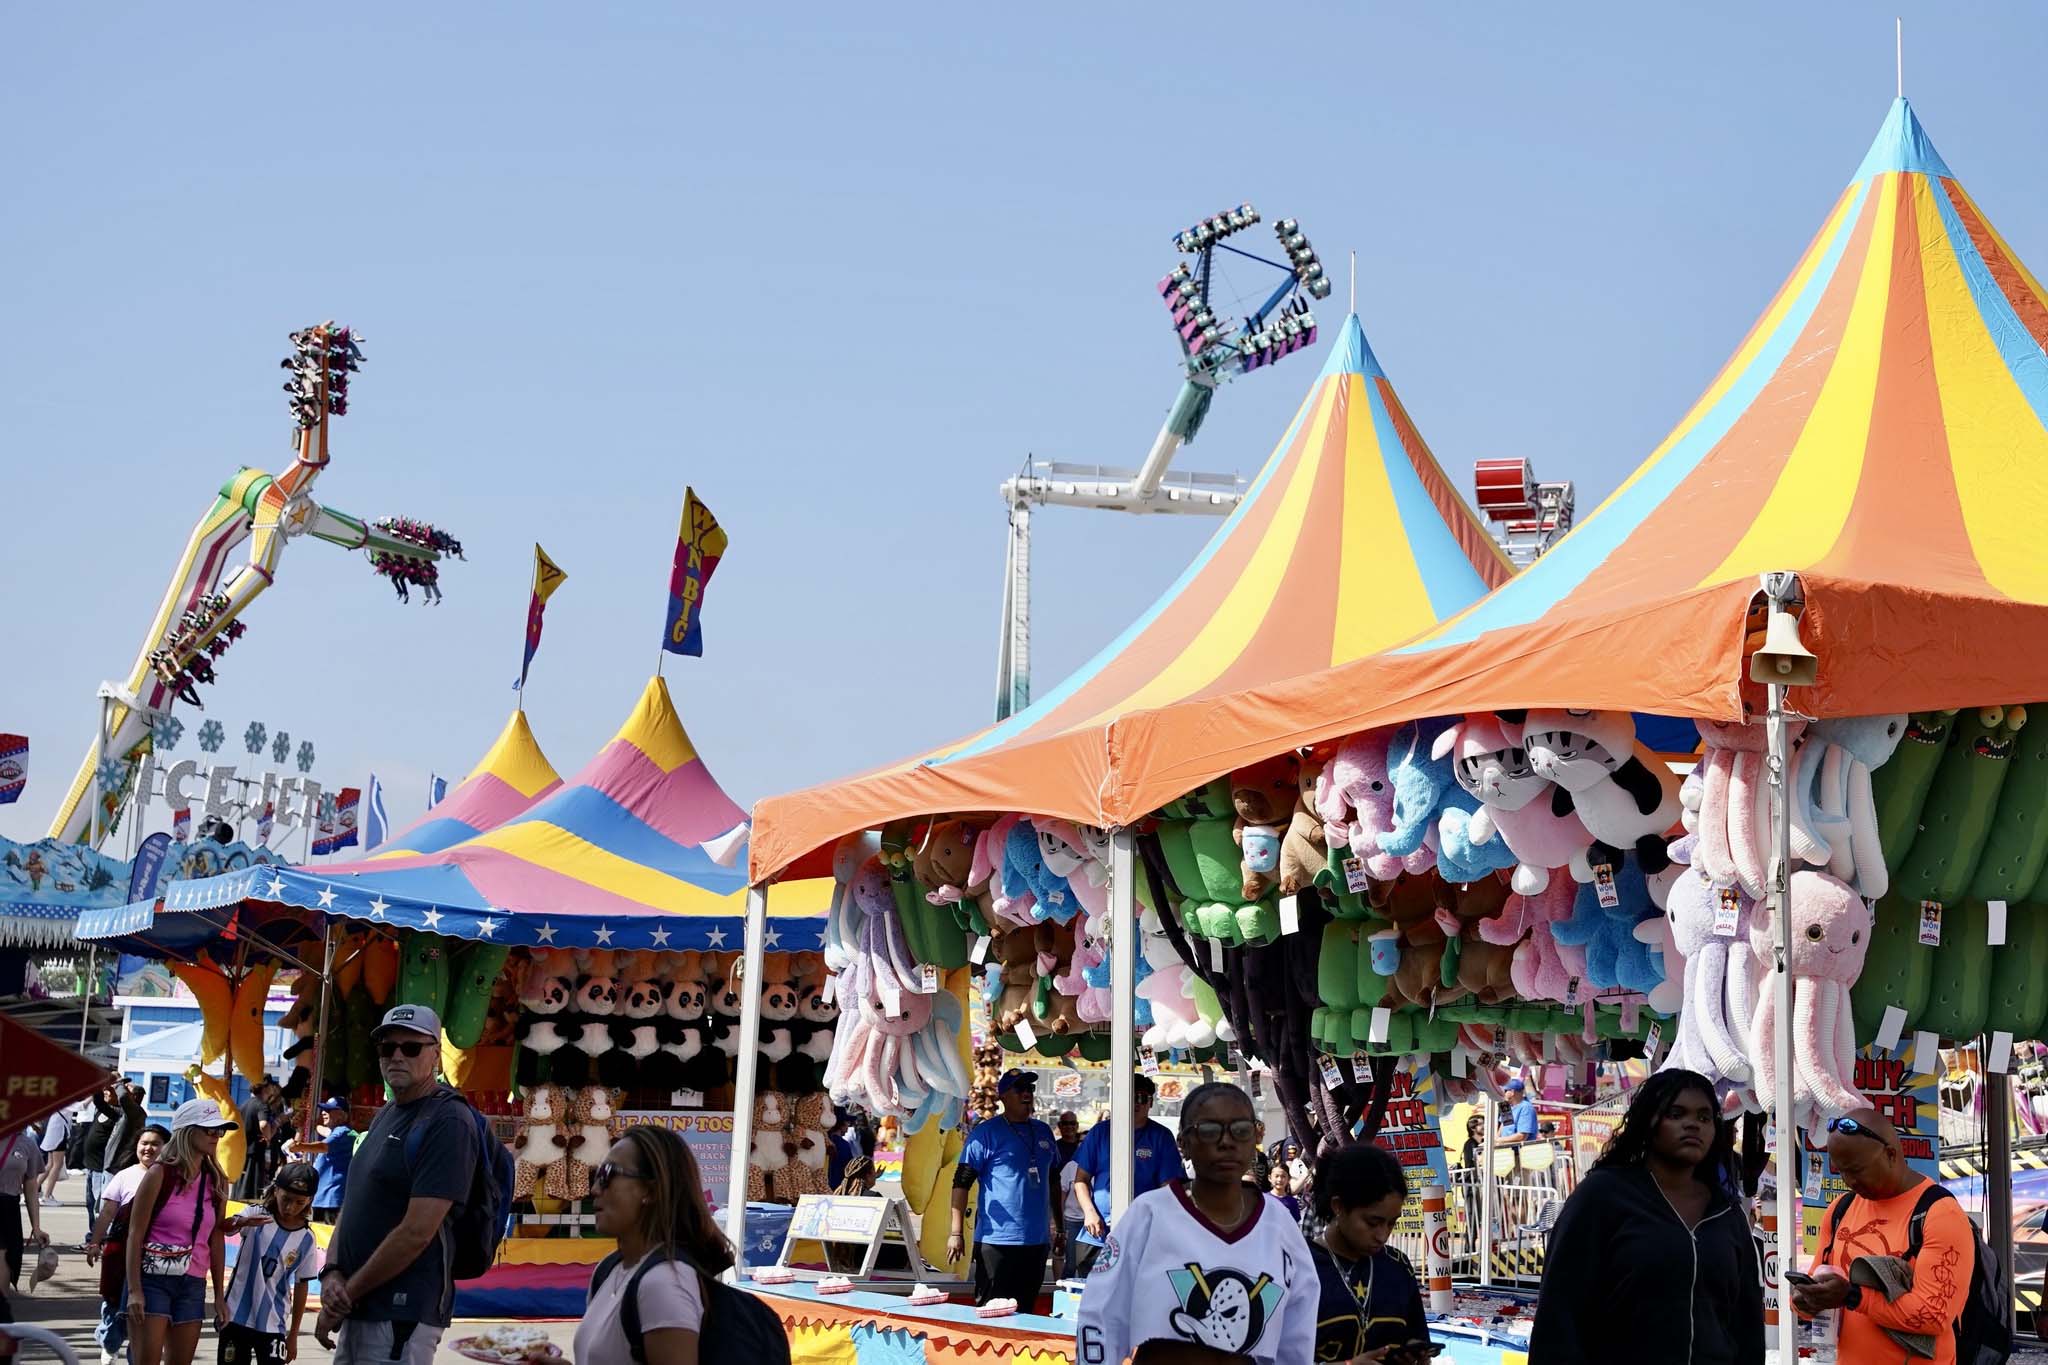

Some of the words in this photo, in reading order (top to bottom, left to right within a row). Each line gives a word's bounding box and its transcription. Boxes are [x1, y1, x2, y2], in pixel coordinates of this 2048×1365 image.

[671, 575, 699, 645] BIG
[131, 753, 238, 818] ICE
[249, 772, 321, 829] JET
[7, 1076, 58, 1097] PER
[695, 1116, 734, 1132] TOS
[1432, 1211, 1447, 1222] SLO
[1763, 1231, 1778, 1244] SLO
[1435, 1266, 1451, 1277] WA
[1764, 1297, 1779, 1309] WA
[269, 1339, 288, 1360] 10
